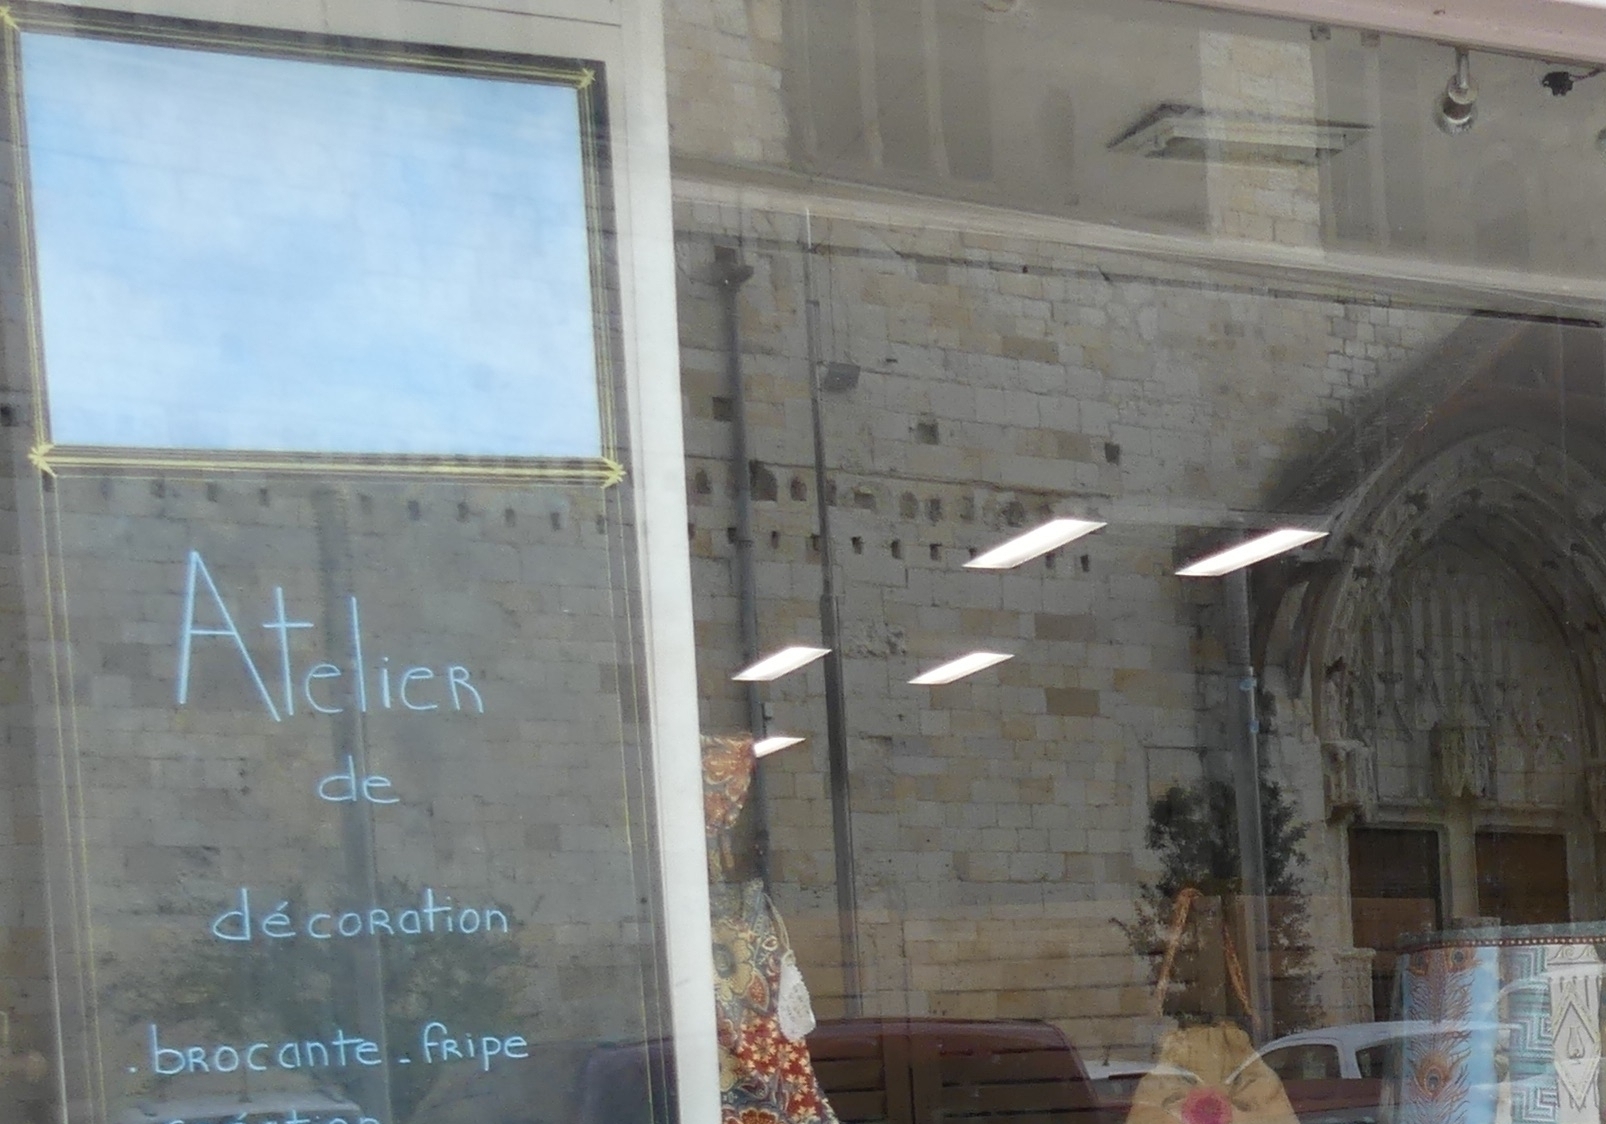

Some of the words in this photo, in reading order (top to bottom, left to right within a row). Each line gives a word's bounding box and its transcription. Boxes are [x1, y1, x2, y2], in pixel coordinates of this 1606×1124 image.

[176, 550, 484, 723] Atelier
[317, 755, 400, 804] de
[210, 887, 509, 942] décoration
[422, 1021, 530, 1072] fripe
